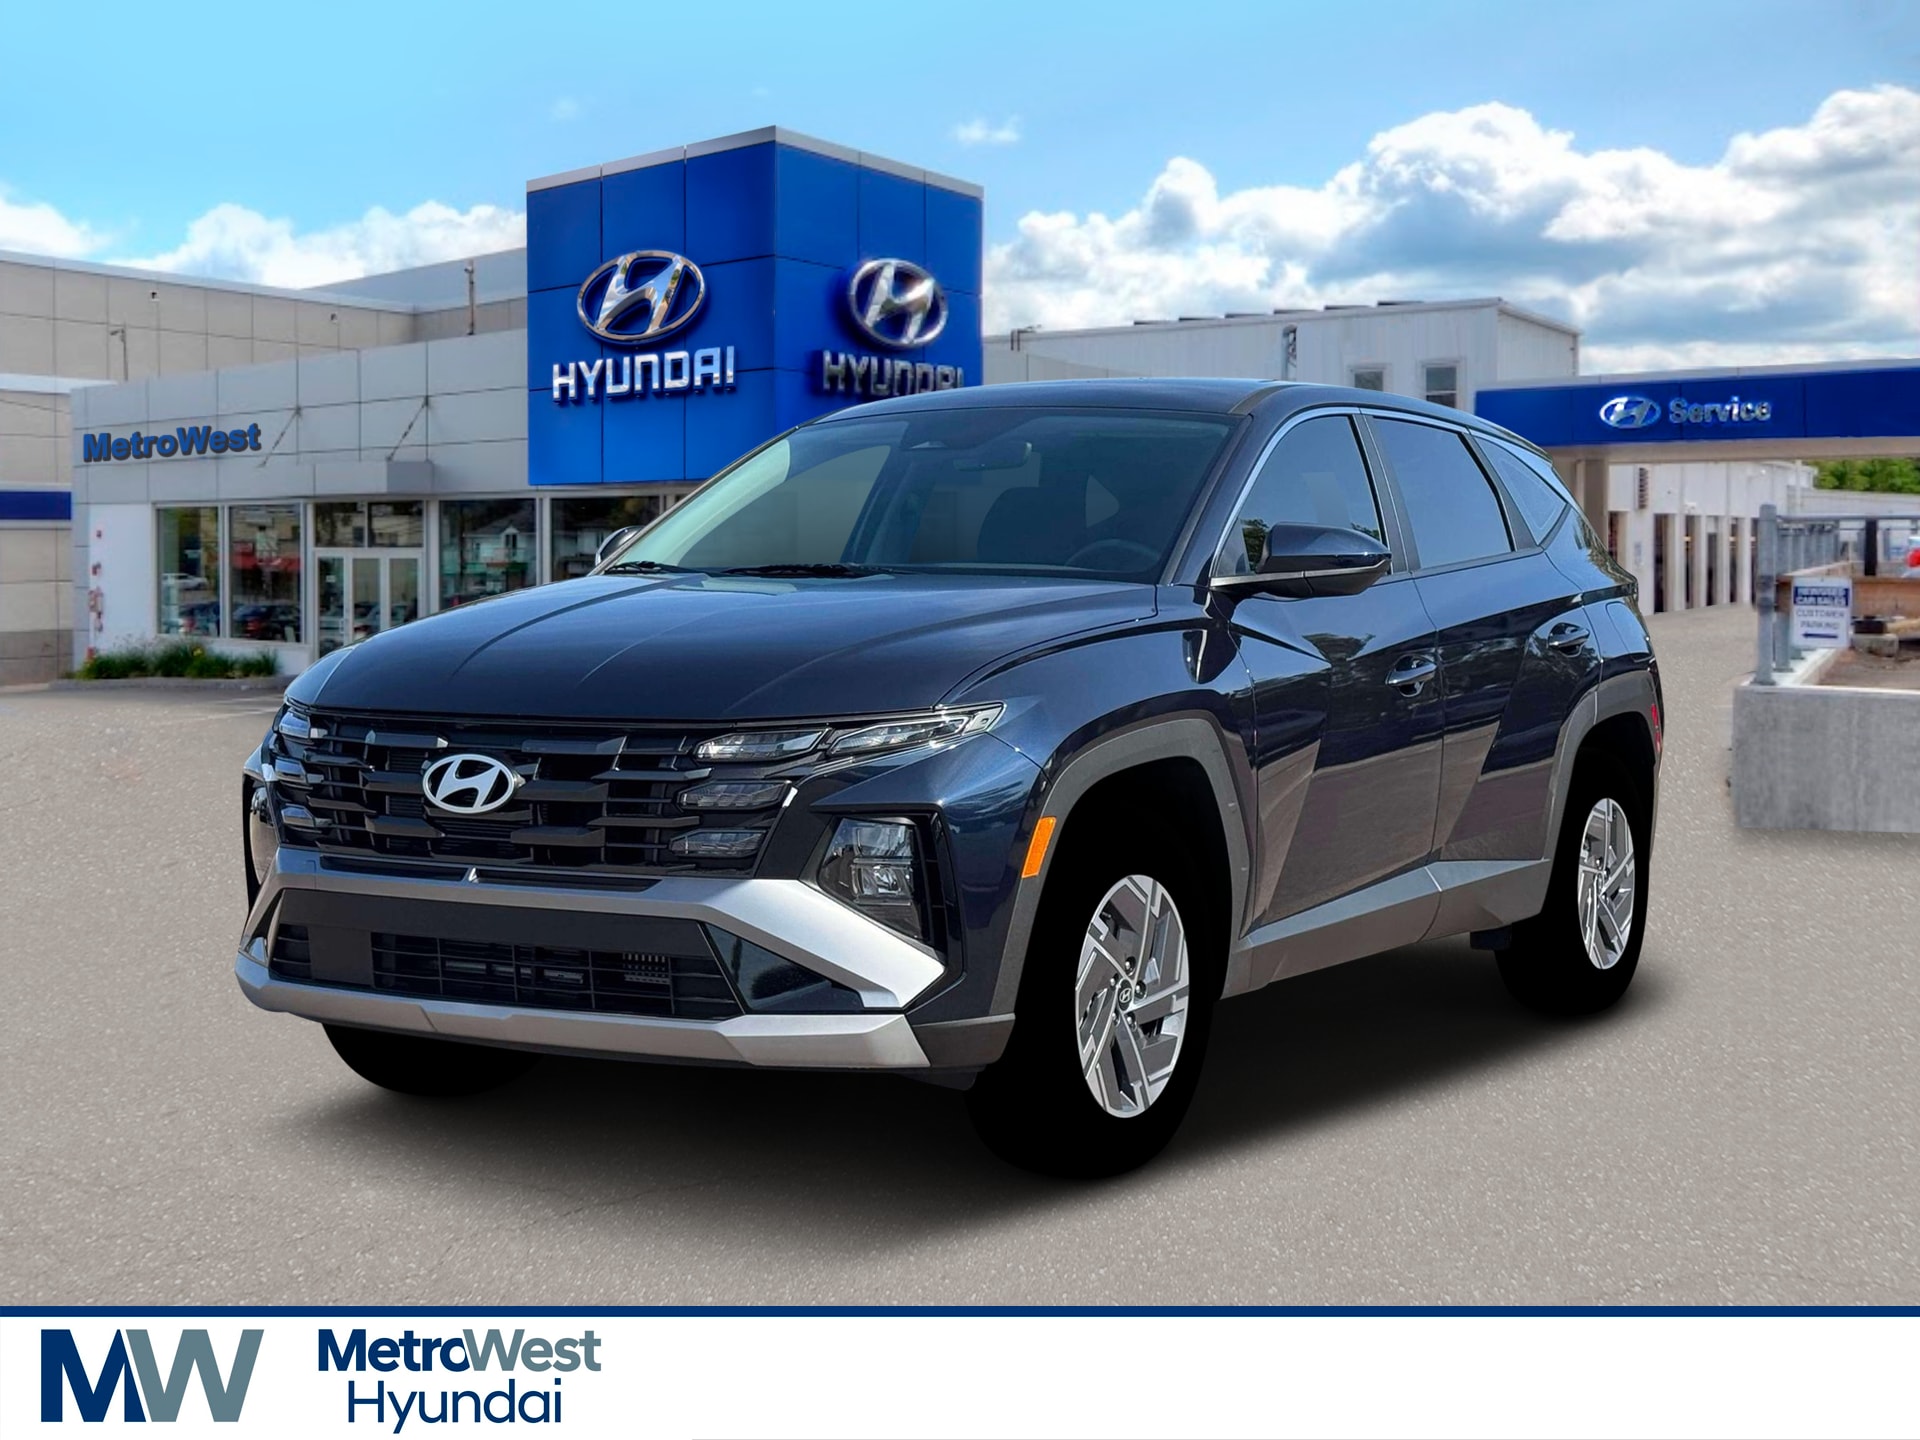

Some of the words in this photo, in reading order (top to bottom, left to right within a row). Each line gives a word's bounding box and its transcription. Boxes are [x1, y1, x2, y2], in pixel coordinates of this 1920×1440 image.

[552, 345, 736, 401] HYUNDAI
[822, 350, 964, 396] HYUNDAI
[1669, 396, 1771, 424] Service
[83, 423, 262, 462] MetroWest
